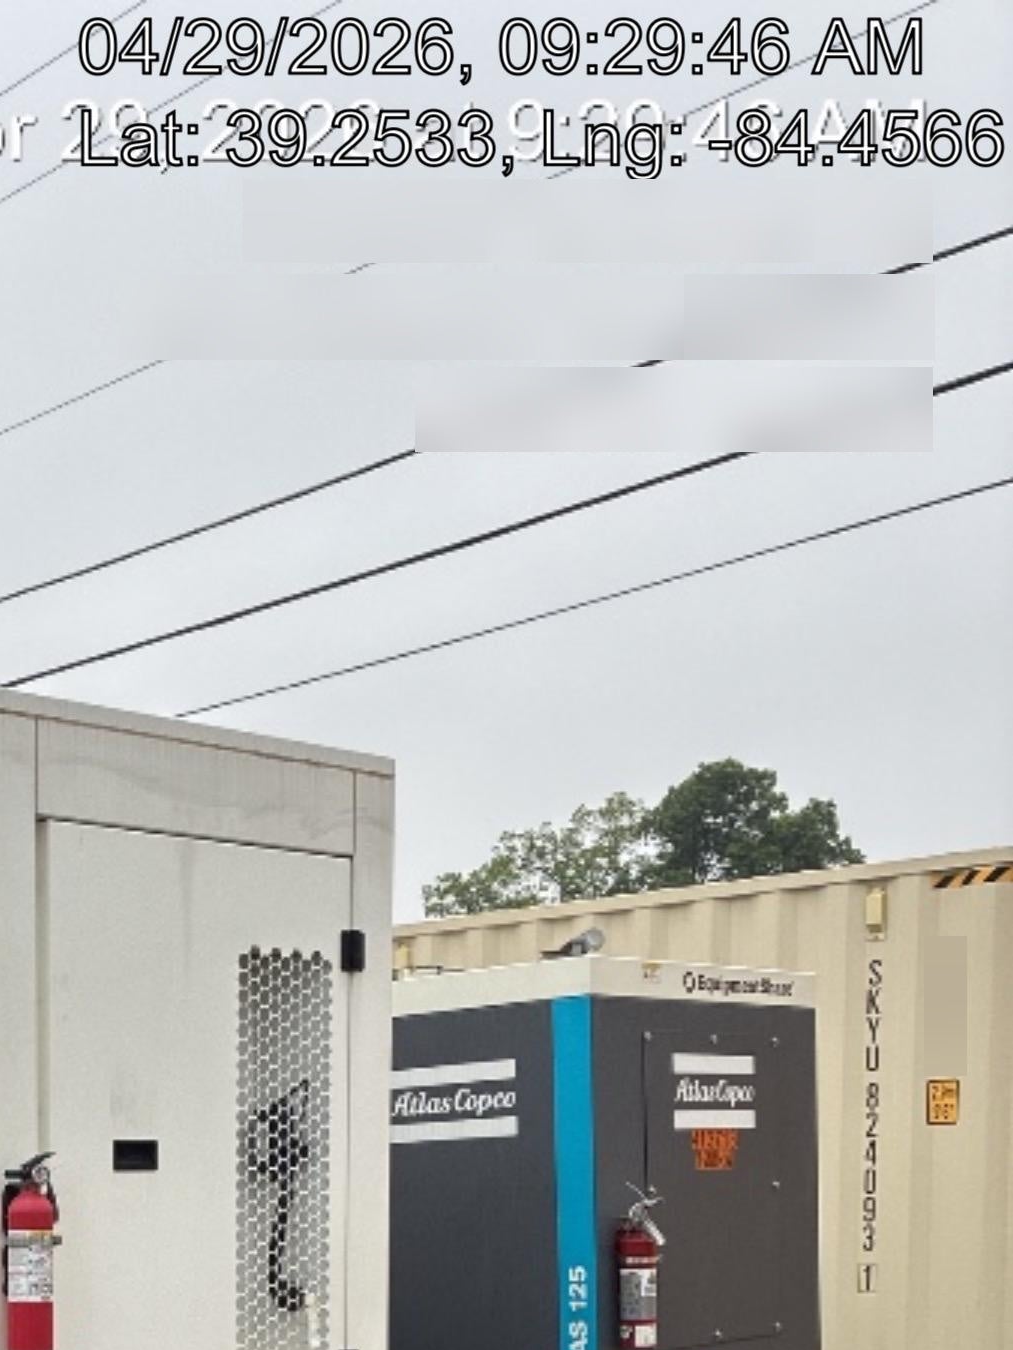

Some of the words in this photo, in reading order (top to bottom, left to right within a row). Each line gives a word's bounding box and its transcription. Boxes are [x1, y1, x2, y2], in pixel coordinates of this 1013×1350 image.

[865, 959, 883, 1072] SKYU
[390, 1090, 452, 1118] Atlas
[453, 1087, 516, 1117] Copco
[673, 1076, 714, 1102] Atlas
[715, 1078, 756, 1108] Copco
[862, 1082, 880, 1252] 824093
[568, 1265, 588, 1312] 125
